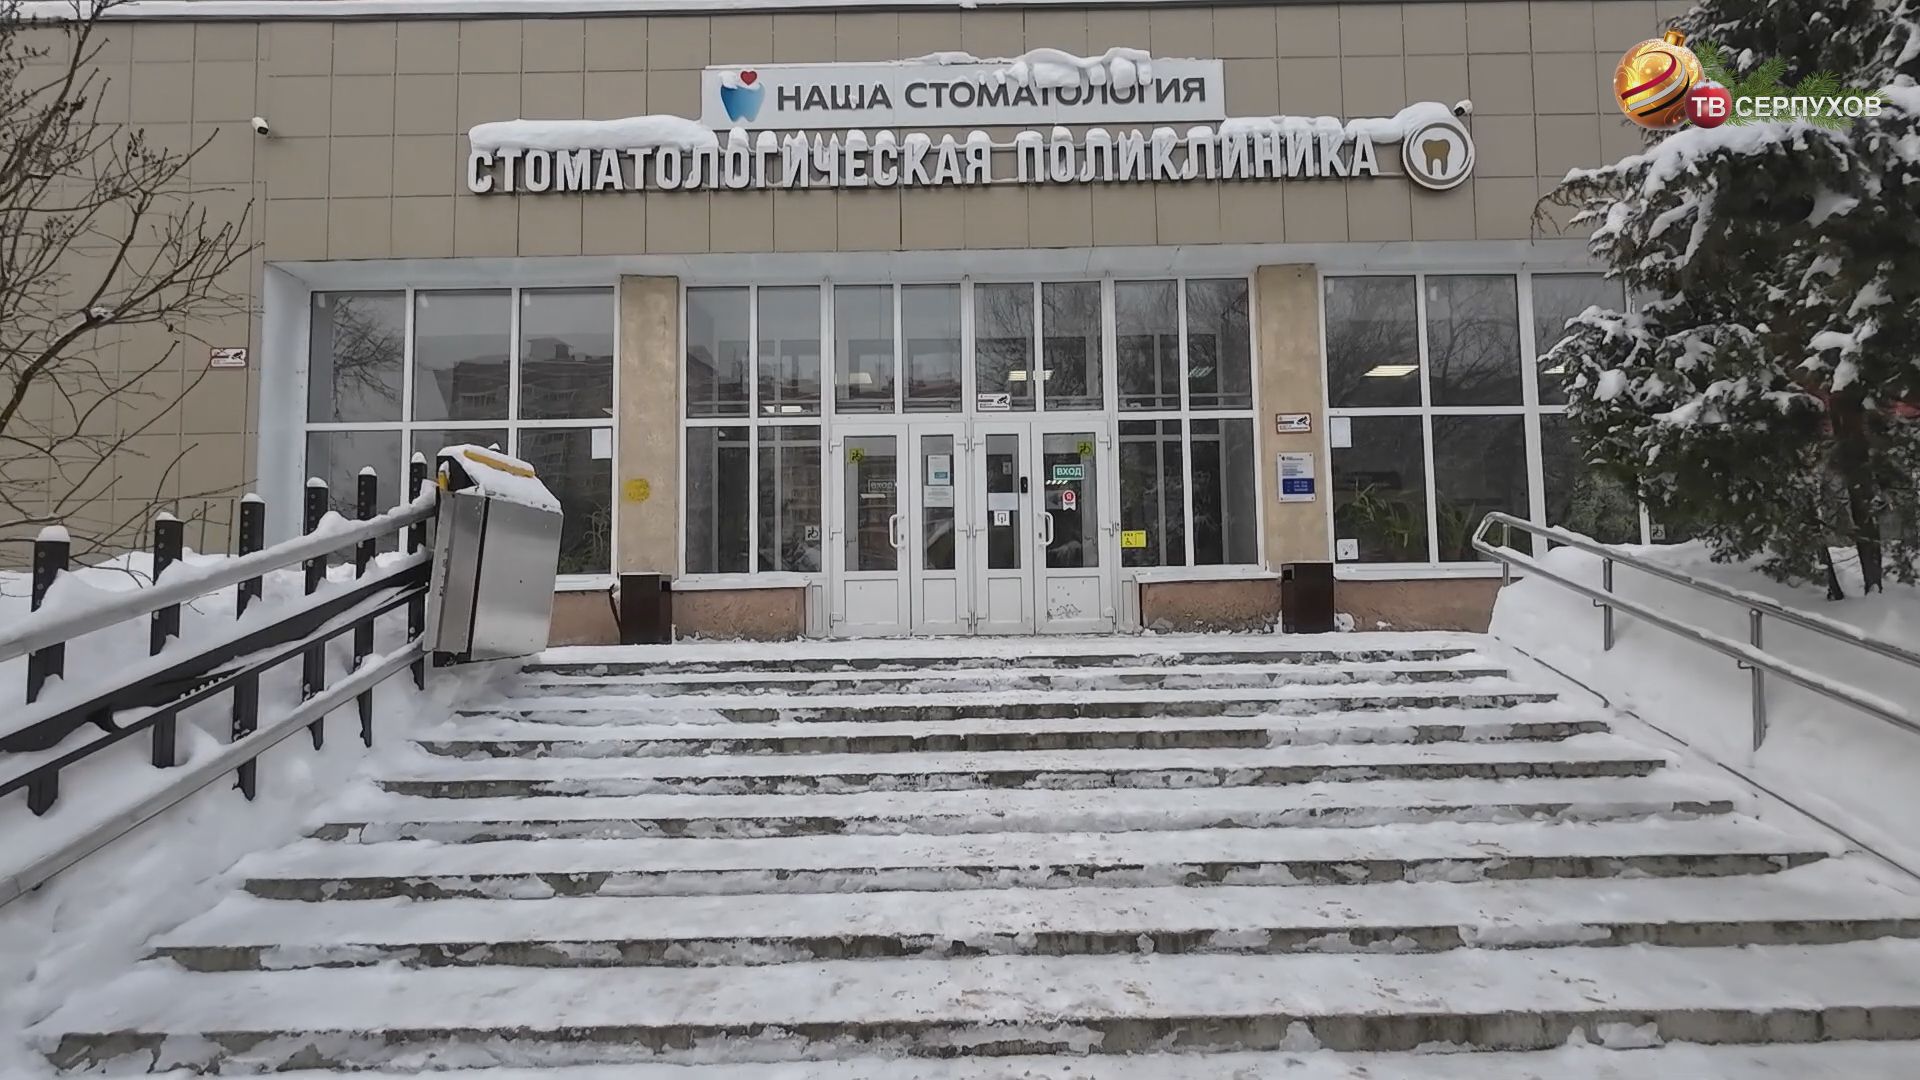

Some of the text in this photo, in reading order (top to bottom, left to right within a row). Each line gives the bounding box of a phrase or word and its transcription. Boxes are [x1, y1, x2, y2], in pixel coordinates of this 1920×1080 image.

[777, 84, 893, 112] НАША
[467, 132, 1380, 194] СТОМАТОЛОГИЧЕСКАЯ ПОЛИКЛИНИКА
[1056, 467, 1082, 477] ВХОД
